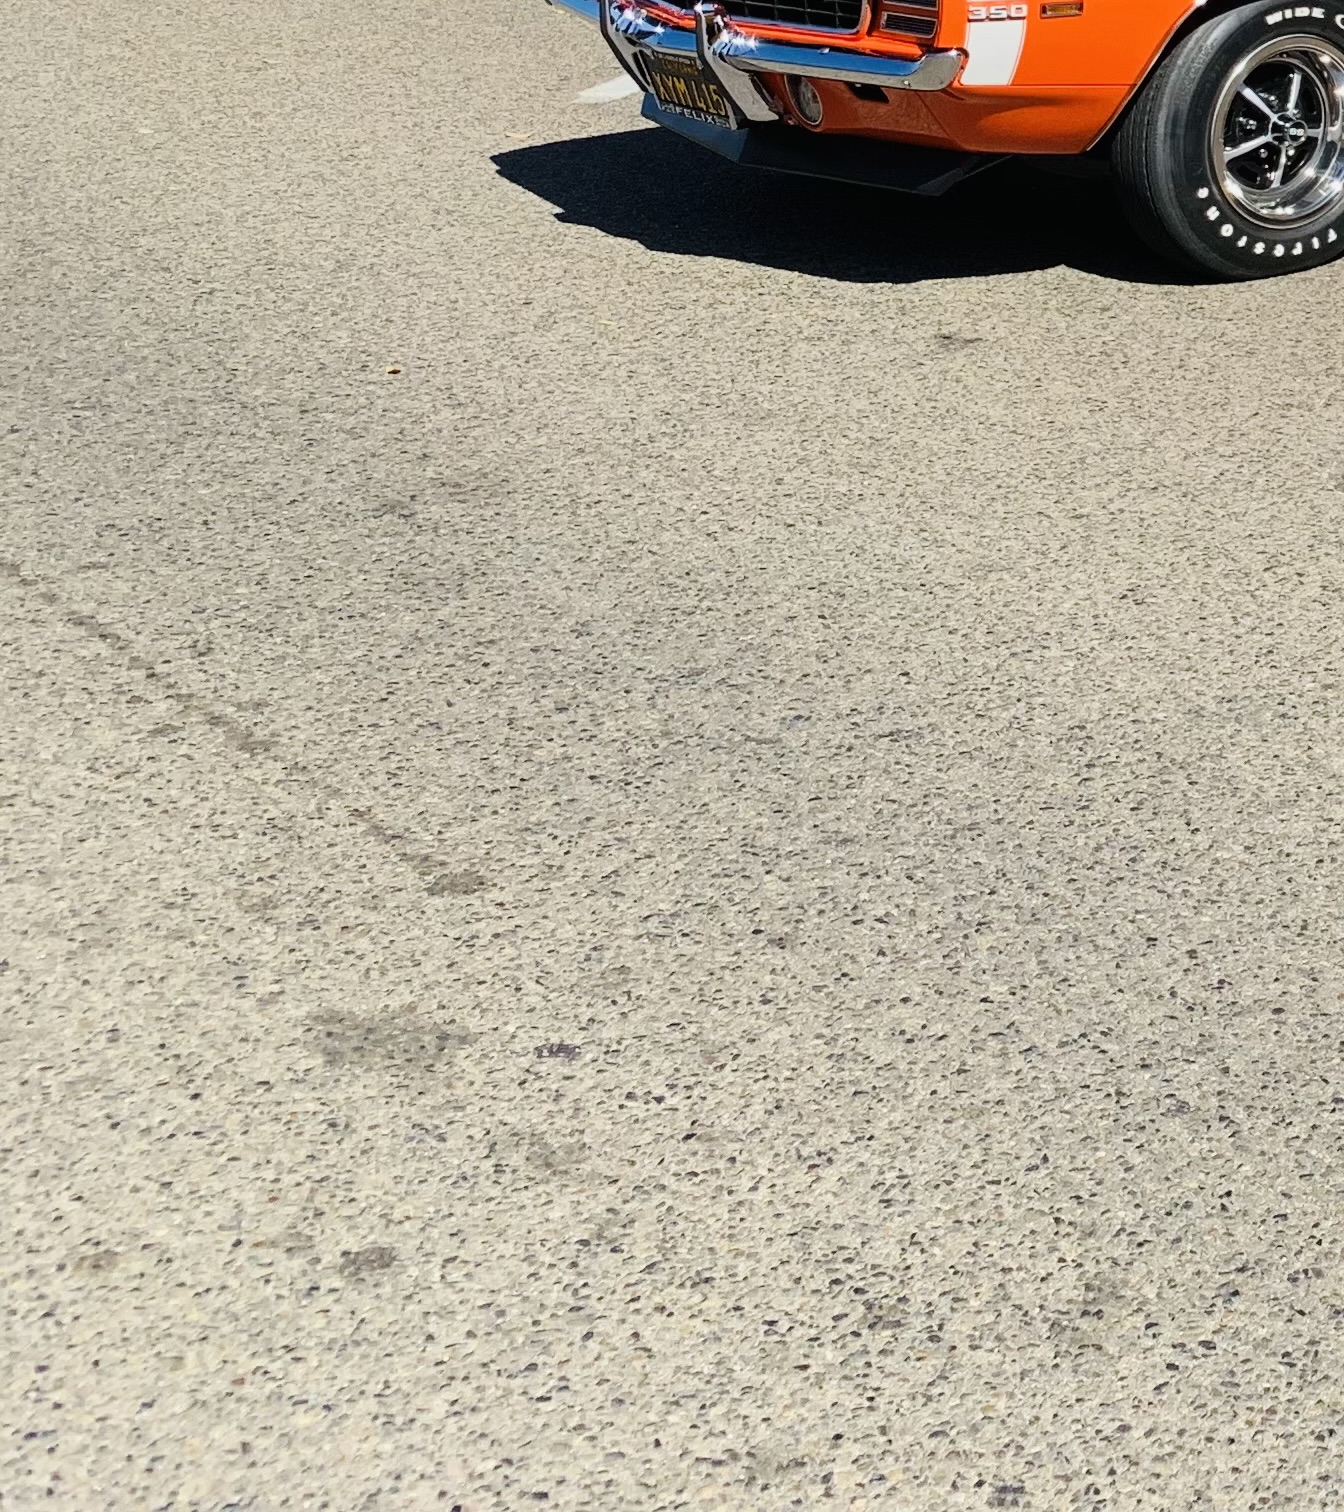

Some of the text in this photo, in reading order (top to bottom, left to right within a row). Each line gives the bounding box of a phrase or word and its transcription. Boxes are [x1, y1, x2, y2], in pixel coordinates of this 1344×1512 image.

[967, 4, 1028, 22] 350
[1265, 6, 1326, 26] WIDE
[651, 71, 693, 108] XYM
[676, 106, 715, 126] FELIX
